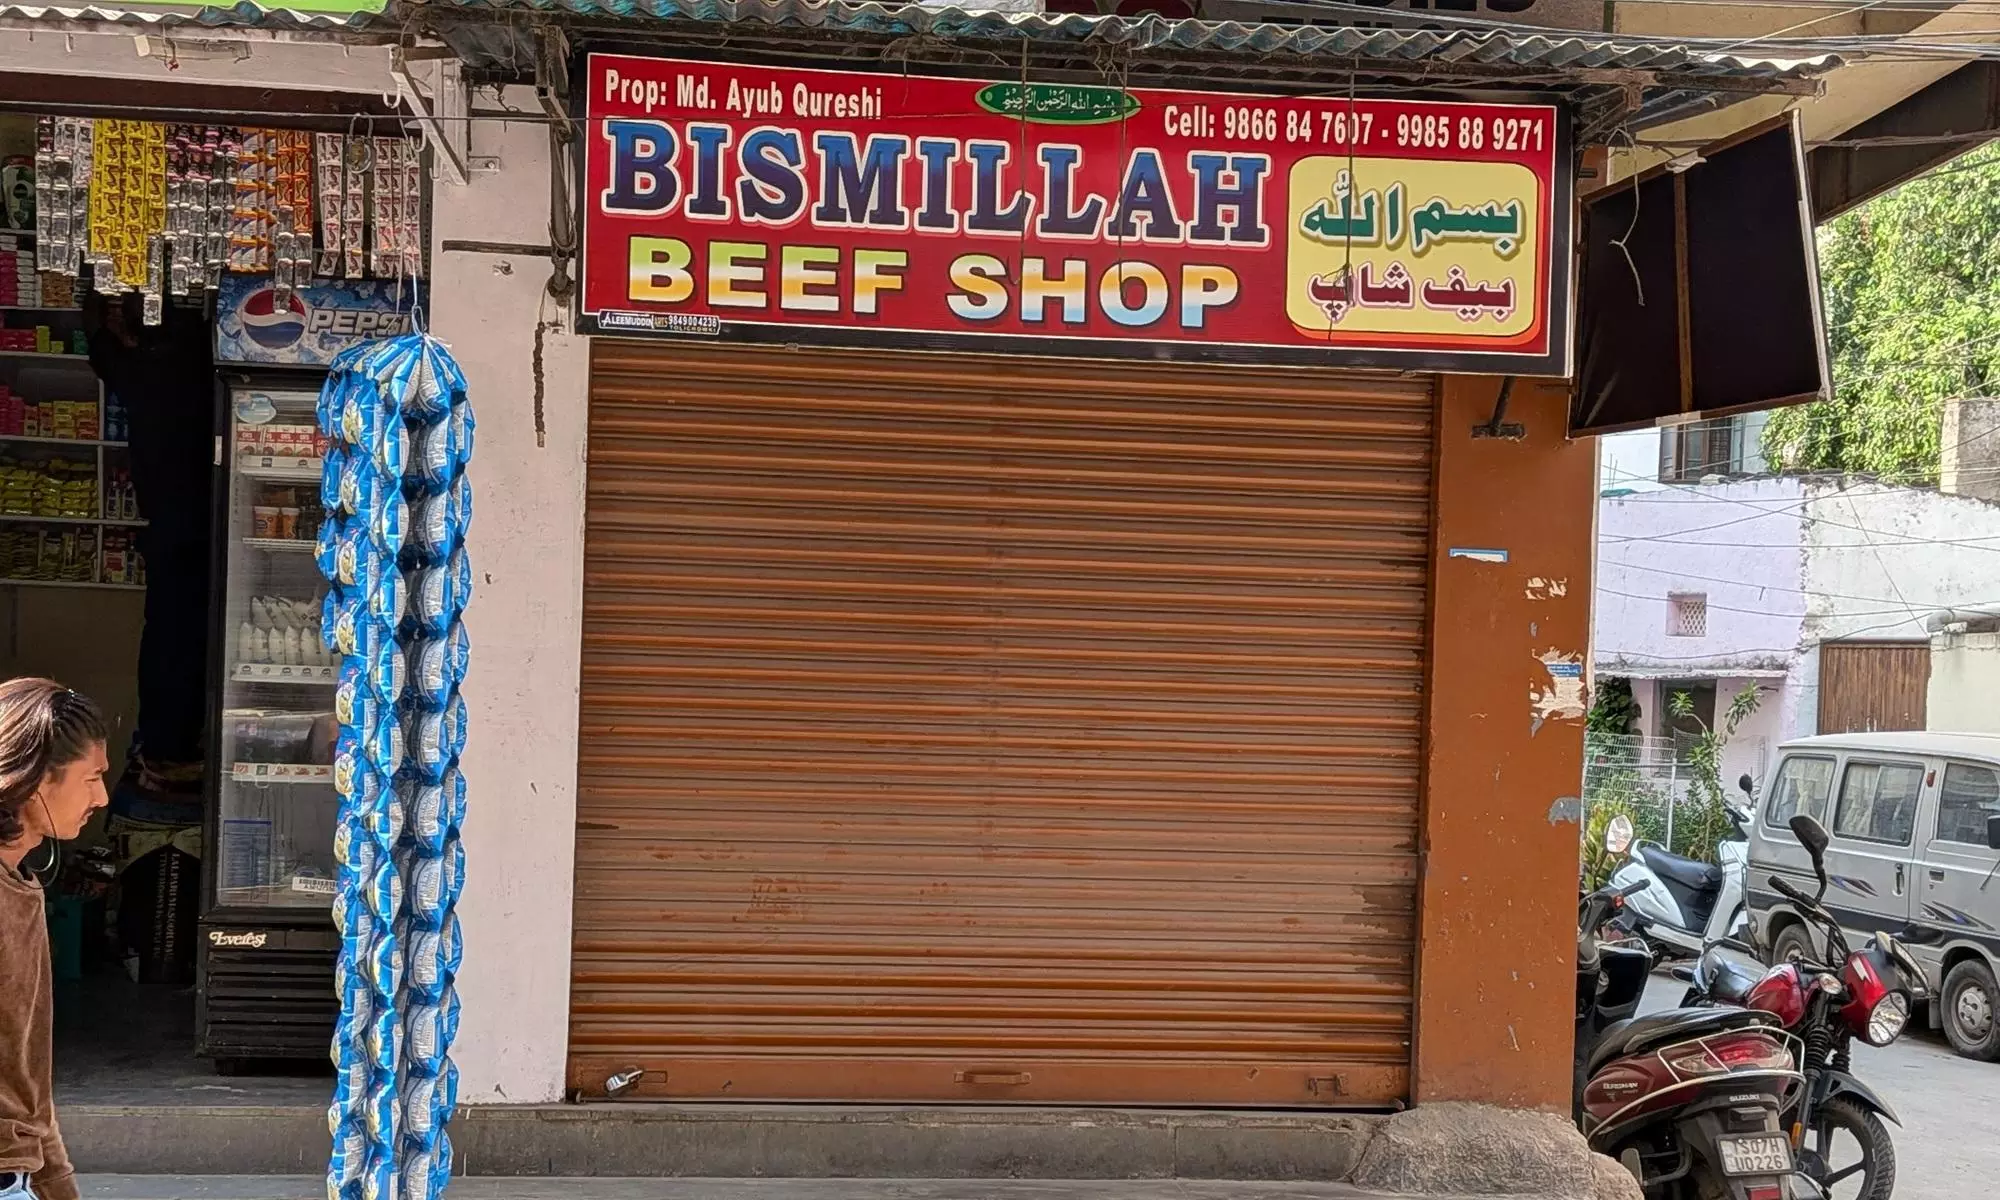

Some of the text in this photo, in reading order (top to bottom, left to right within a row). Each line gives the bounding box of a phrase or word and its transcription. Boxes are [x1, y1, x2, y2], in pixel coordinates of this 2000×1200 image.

[605, 69, 881, 119] Prop: Md. Ayub Qureshi
[1164, 105, 1543, 151] Cell: 9866 84 7607 - 9985 88 9271
[602, 117, 1271, 248] BISMILLAH
[1410, 196, 1522, 255] بسم
[628, 235, 1240, 329] BEEF SHOP
[308, 308, 411, 337] PEPSI
[209, 931, 267, 948] Everest
[1728, 1093, 1761, 1102] SUZUKI
